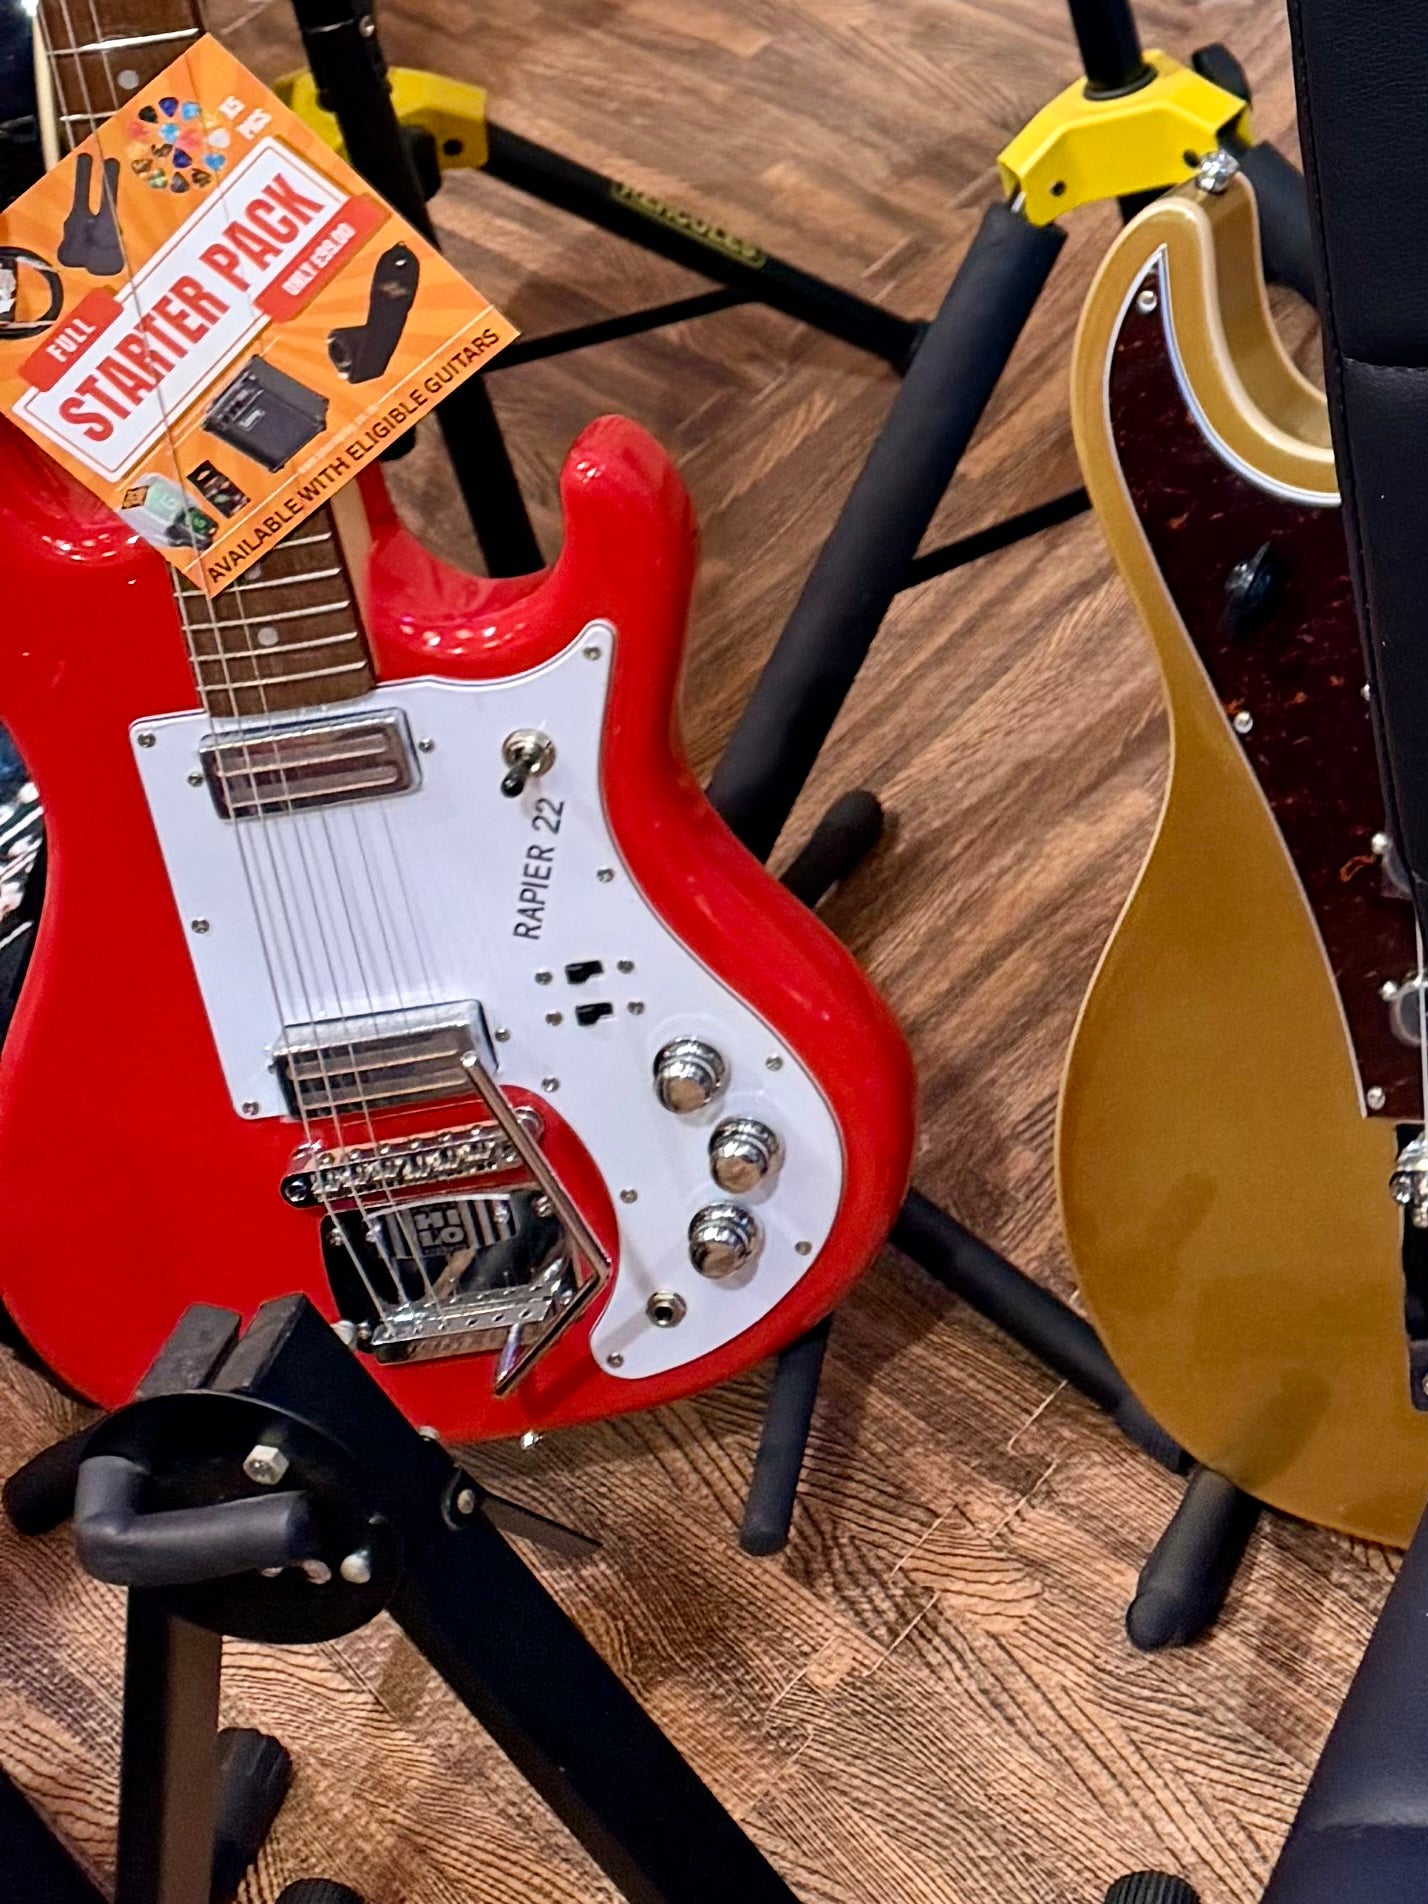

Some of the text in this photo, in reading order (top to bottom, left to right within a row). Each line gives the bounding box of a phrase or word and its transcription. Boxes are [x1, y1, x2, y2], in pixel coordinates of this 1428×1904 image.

[46, 316, 96, 363] FULL
[59, 173, 325, 442] STARTER PACK
[206, 500, 304, 584] AVAILABLE
[297, 457, 351, 503] WITH
[344, 387, 428, 463] ELIGIBLE
[423, 327, 500, 394] GUITARS
[512, 797, 565, 941] RAPIER 22
